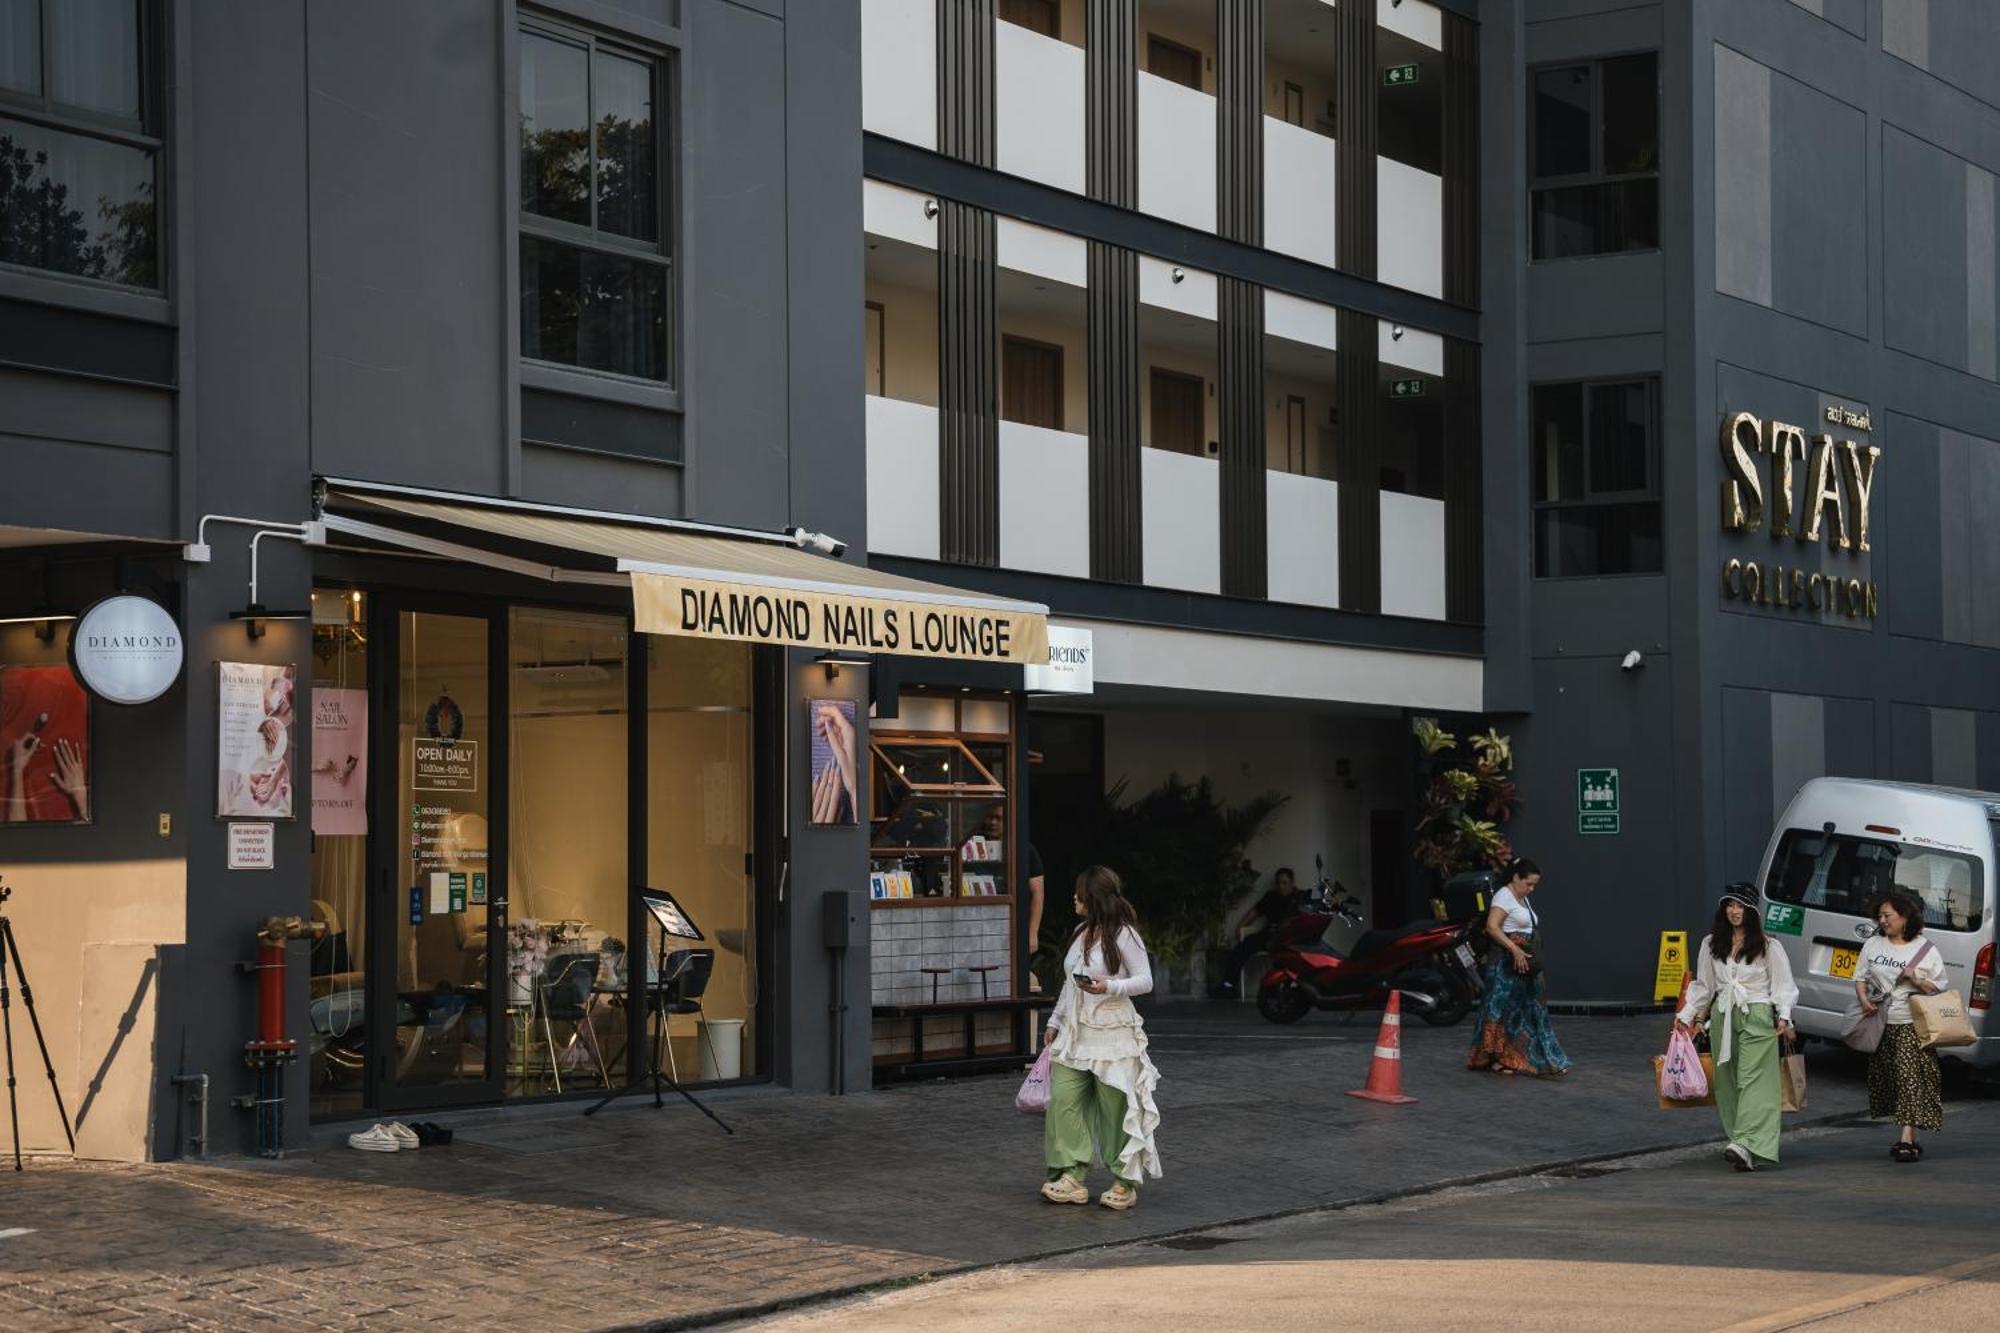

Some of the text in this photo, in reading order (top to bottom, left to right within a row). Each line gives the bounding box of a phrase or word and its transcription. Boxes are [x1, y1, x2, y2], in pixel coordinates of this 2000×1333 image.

[1724, 411, 1881, 551] STAY
[1724, 557, 1877, 617] COLLECTION
[681, 588, 1010, 657] DIAMOND NAILS LOUNGE
[88, 636, 176, 648] DIAMOND
[315, 713, 348, 725] SALON
[416, 747, 473, 761] OPEN DAILY
